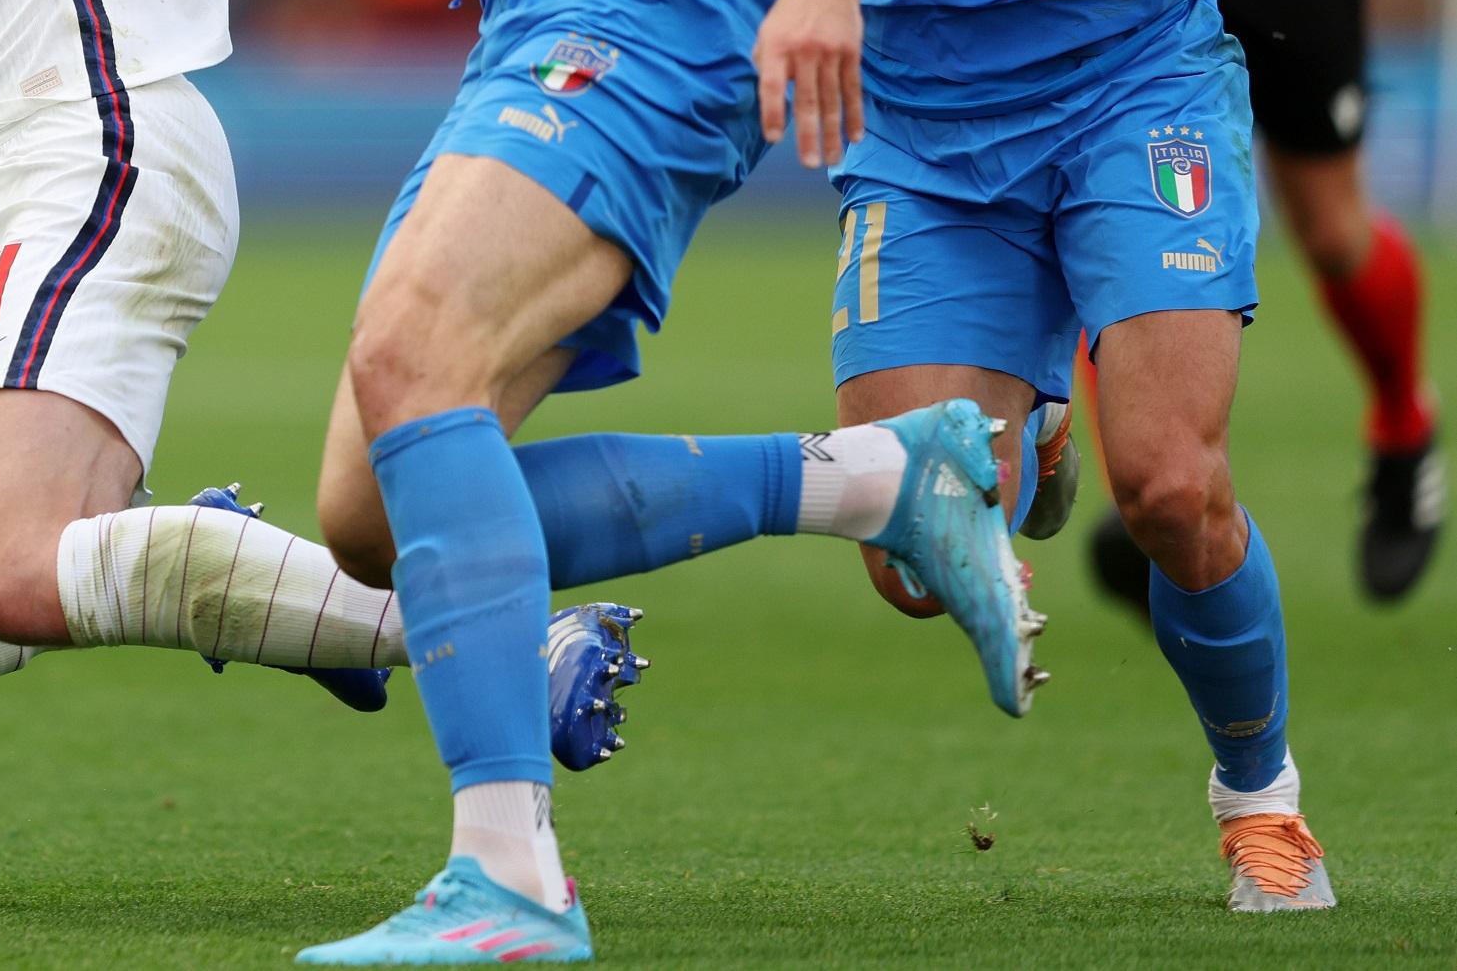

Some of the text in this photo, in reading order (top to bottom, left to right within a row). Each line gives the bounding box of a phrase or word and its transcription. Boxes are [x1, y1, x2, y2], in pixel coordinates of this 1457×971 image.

[498, 106, 555, 143] PUMA
[1155, 147, 1204, 160] ITALIA
[1162, 252, 1217, 273] PUMA
